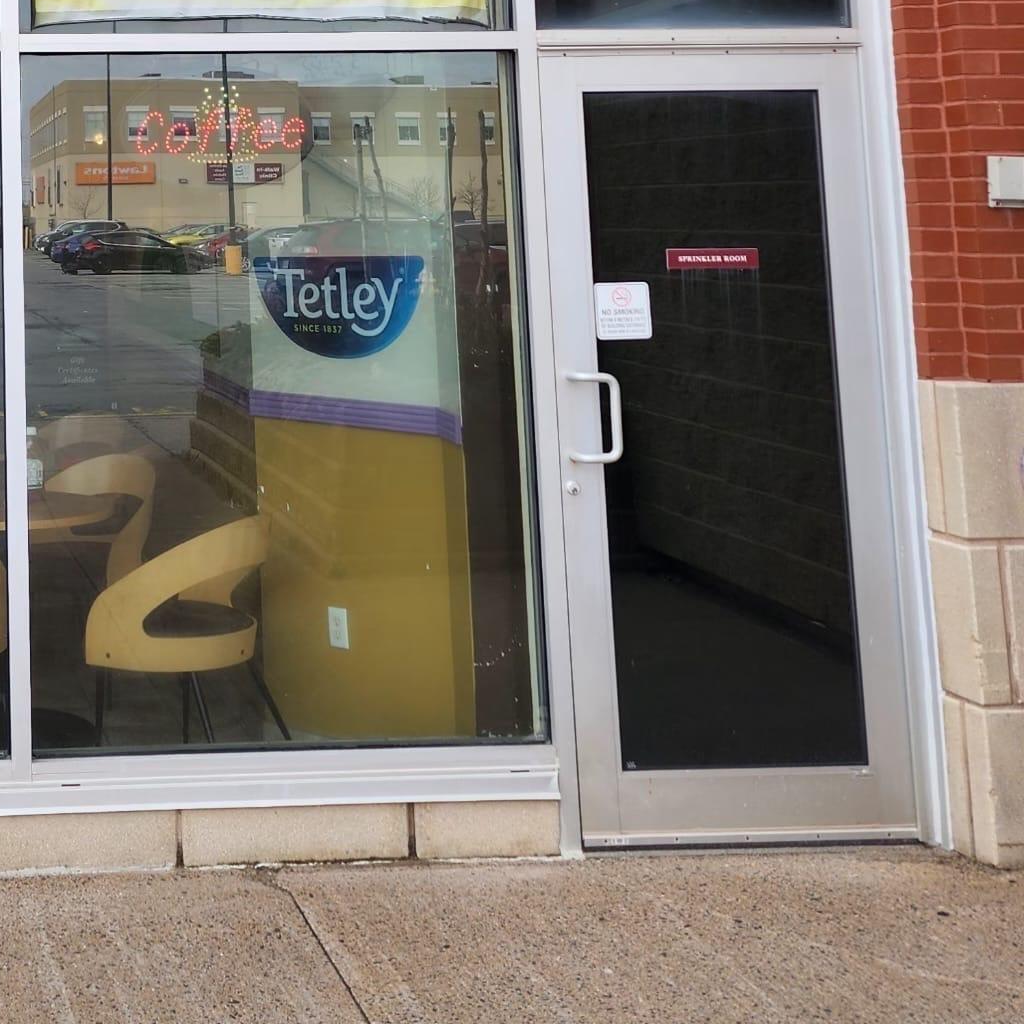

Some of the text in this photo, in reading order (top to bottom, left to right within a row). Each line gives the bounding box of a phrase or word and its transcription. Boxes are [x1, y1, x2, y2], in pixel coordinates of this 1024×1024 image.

[677, 255, 747, 263] SPRINKLER ROOM
[272, 267, 403, 337] Tetley
[294, 324, 343, 334] SINCE 1837
